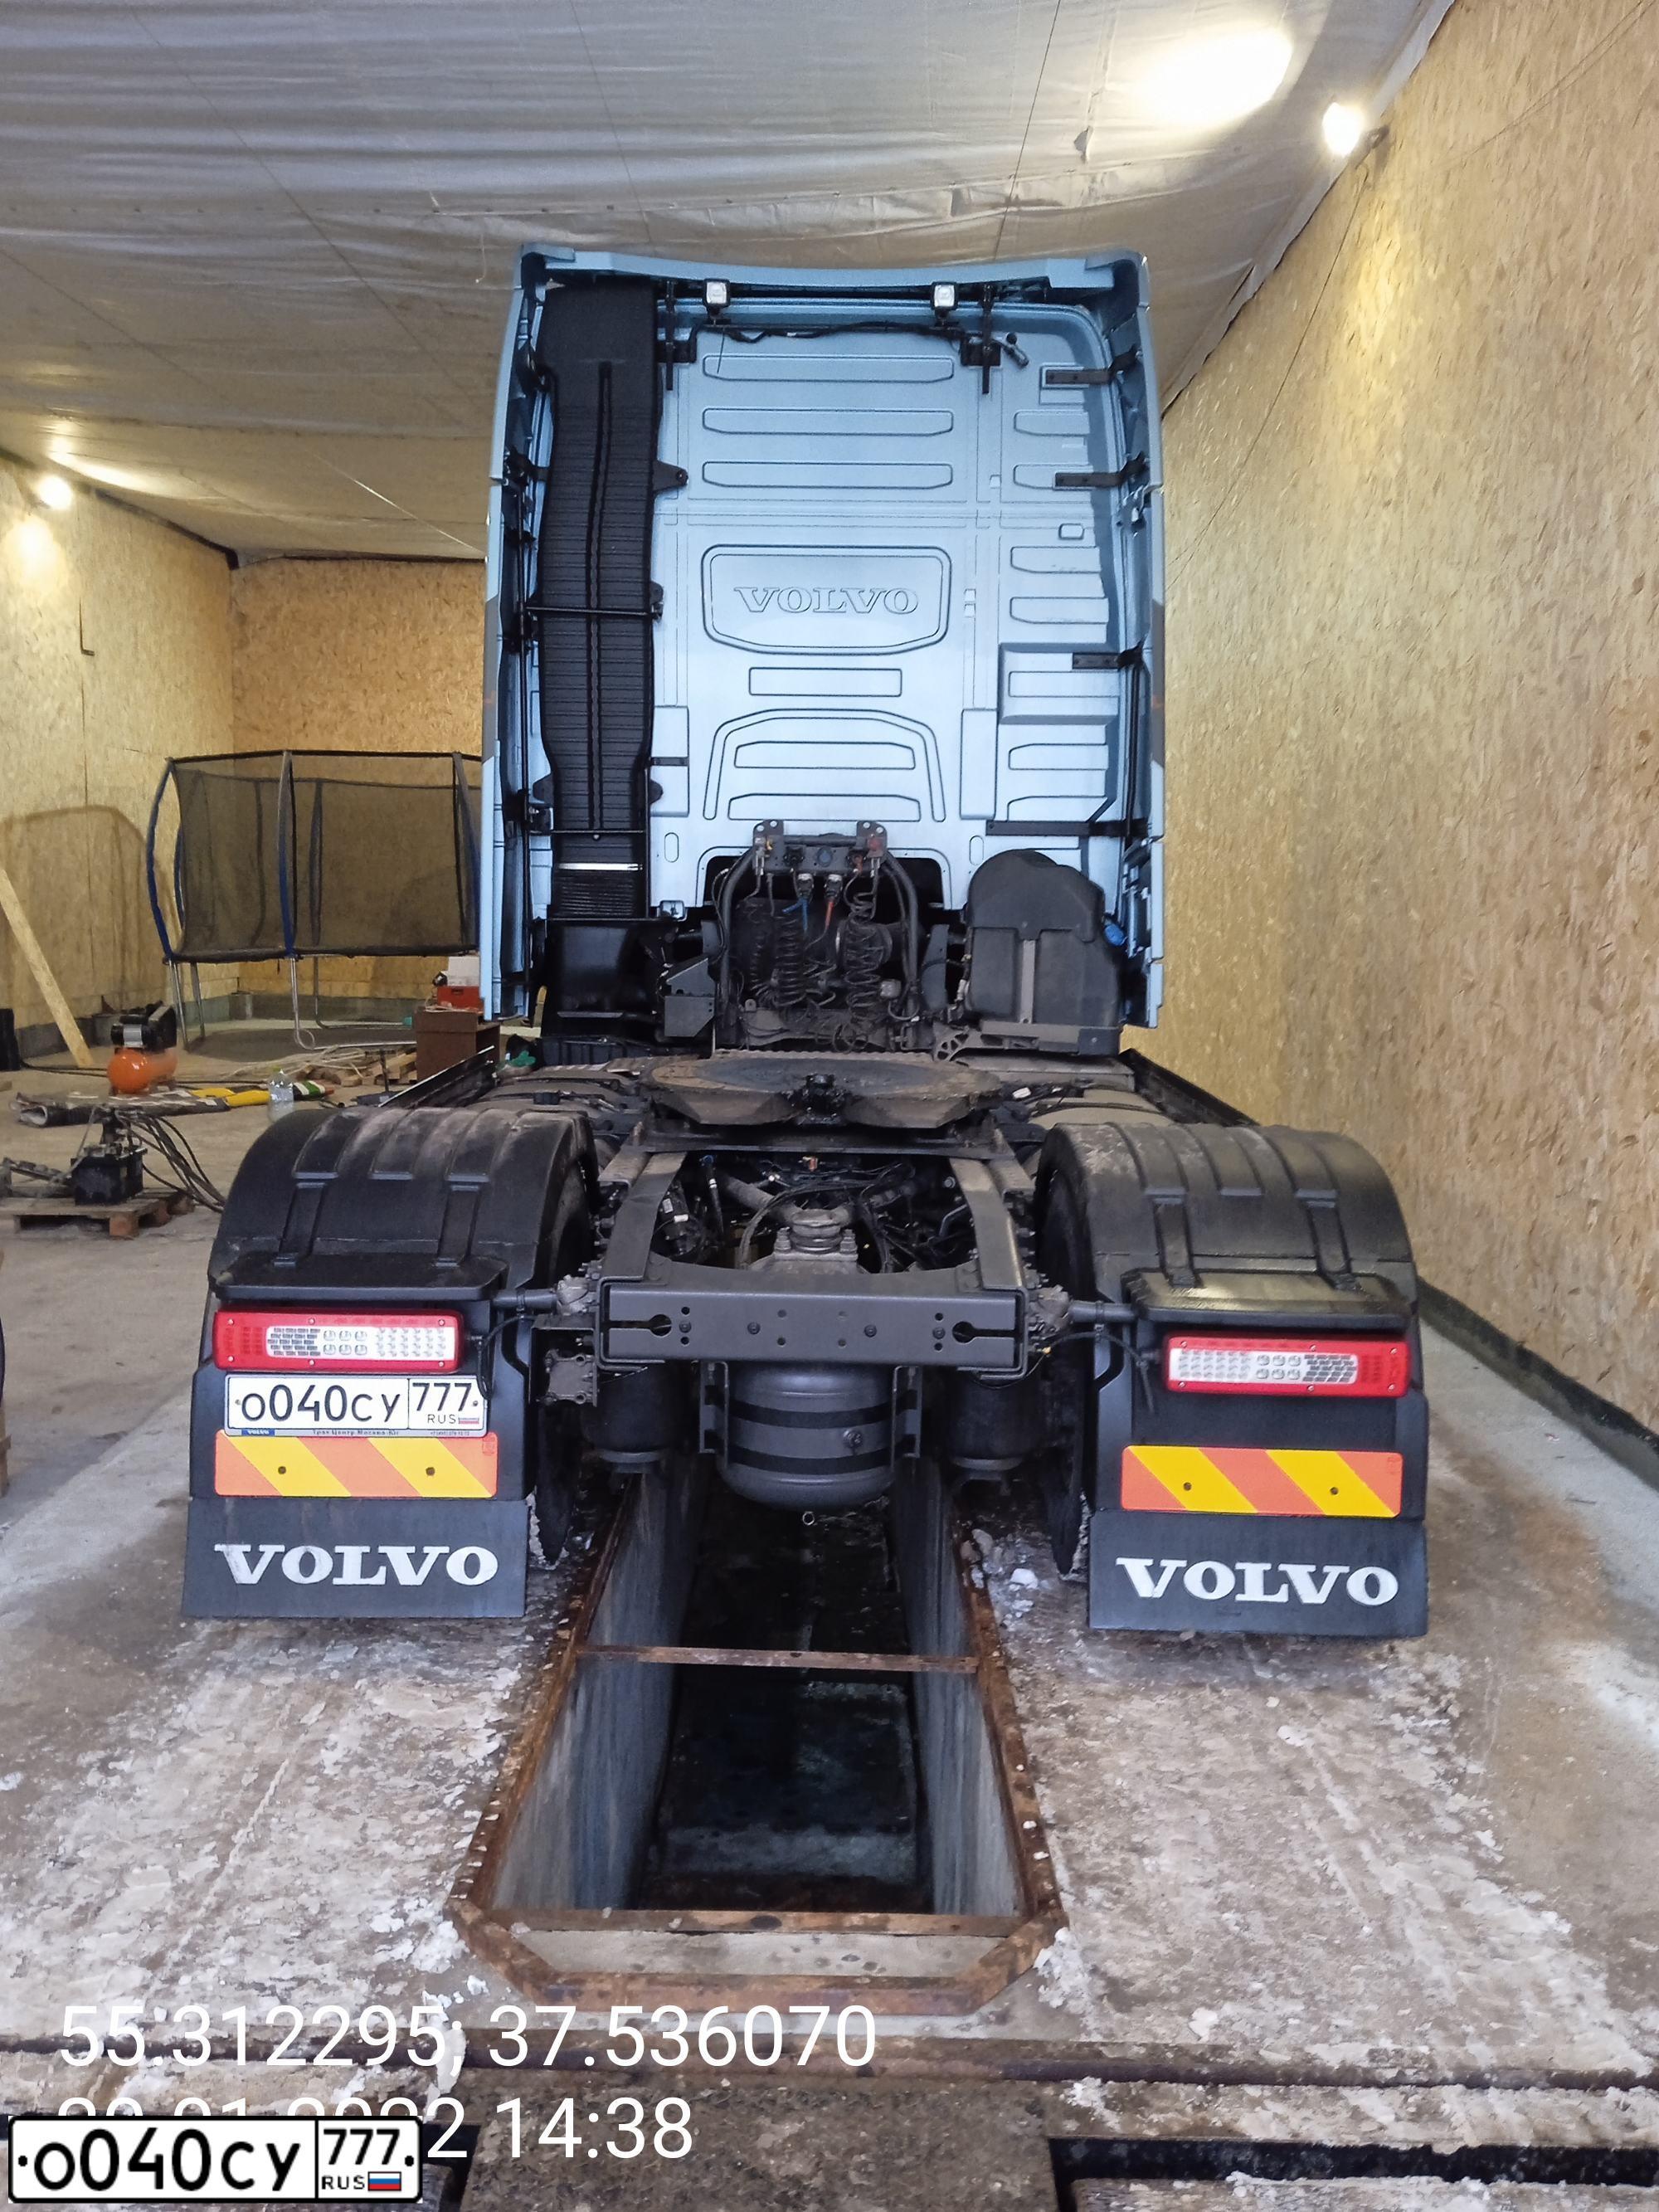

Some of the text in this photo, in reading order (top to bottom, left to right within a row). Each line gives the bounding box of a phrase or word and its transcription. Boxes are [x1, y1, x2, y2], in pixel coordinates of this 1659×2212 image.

[733, 587, 919, 614] VOLVO
[412, 1382, 473, 1411] 777
[427, 1414, 456, 1424] RUS
[214, 1544, 499, 1586] VOLVO
[1116, 1557, 1399, 1606] VOLVO
